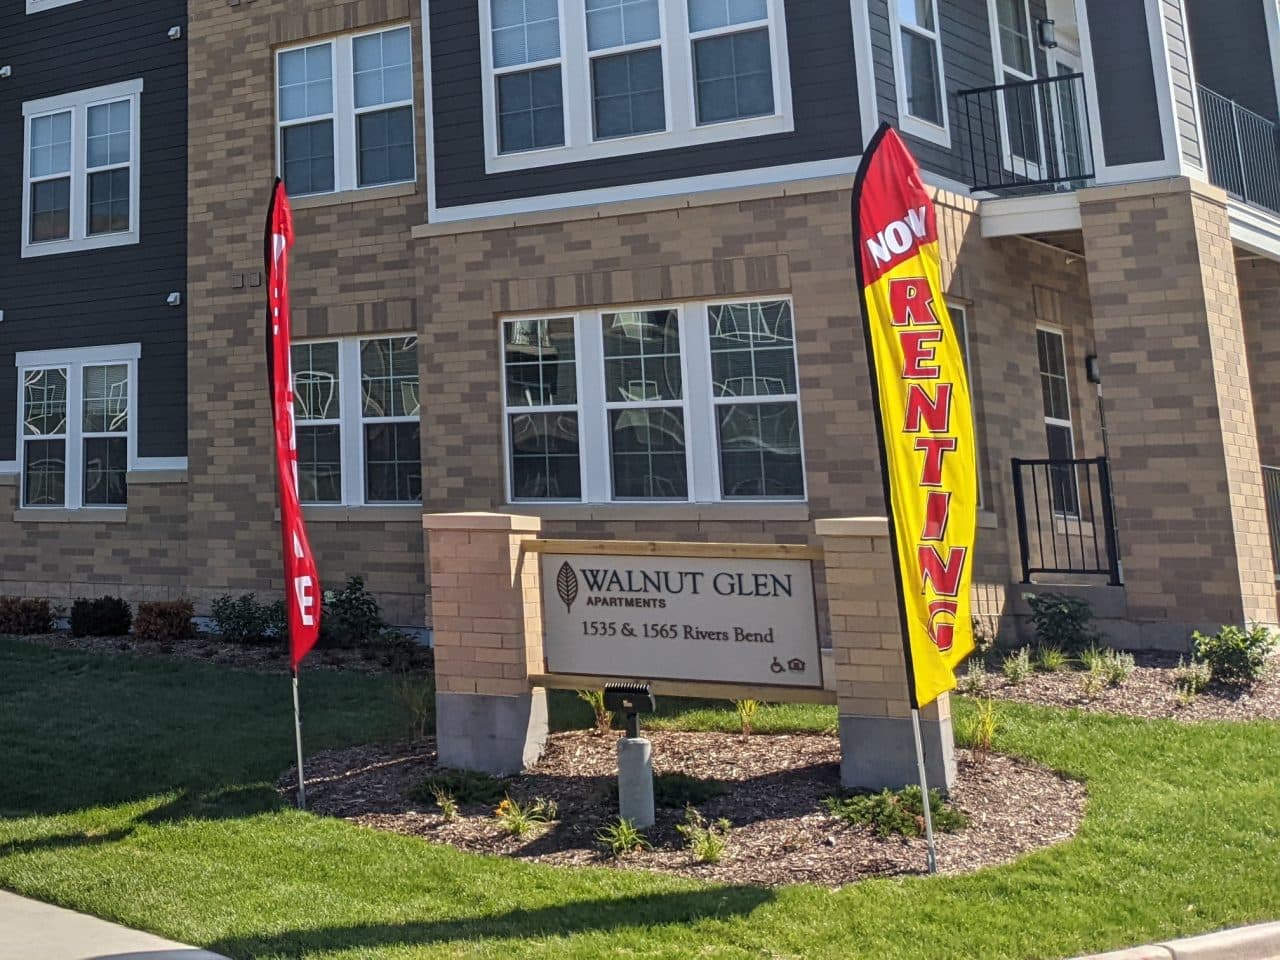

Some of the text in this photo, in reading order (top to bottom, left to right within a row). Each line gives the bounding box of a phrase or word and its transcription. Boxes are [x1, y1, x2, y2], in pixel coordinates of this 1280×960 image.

[886, 276, 968, 652] RENTING
[580, 568, 792, 597] WALNUT GLEN
[586, 596, 667, 609] APARTMENTS
[582, 621, 774, 643] 1535 & 1565 Rivers Bend
